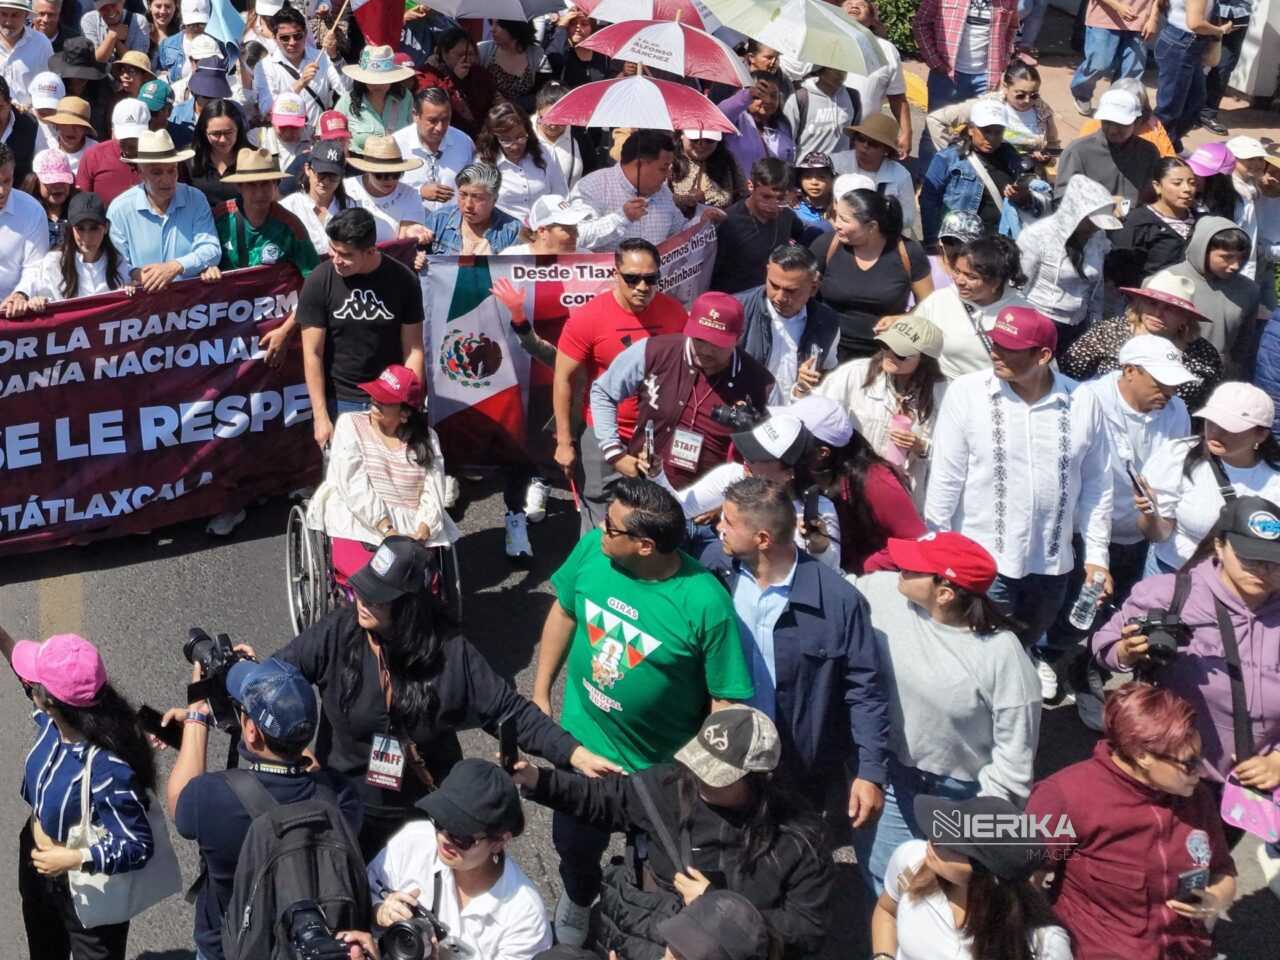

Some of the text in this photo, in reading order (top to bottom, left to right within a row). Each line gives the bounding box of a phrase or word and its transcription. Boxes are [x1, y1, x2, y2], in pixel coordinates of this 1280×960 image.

[326, 148, 338, 162] NY
[513, 266, 618, 280] Desde Tlax
[46, 326, 92, 357] LA
[93, 334, 274, 392] NACIONAL
[55, 409, 128, 464] LE
[673, 439, 699, 453] STAFF
